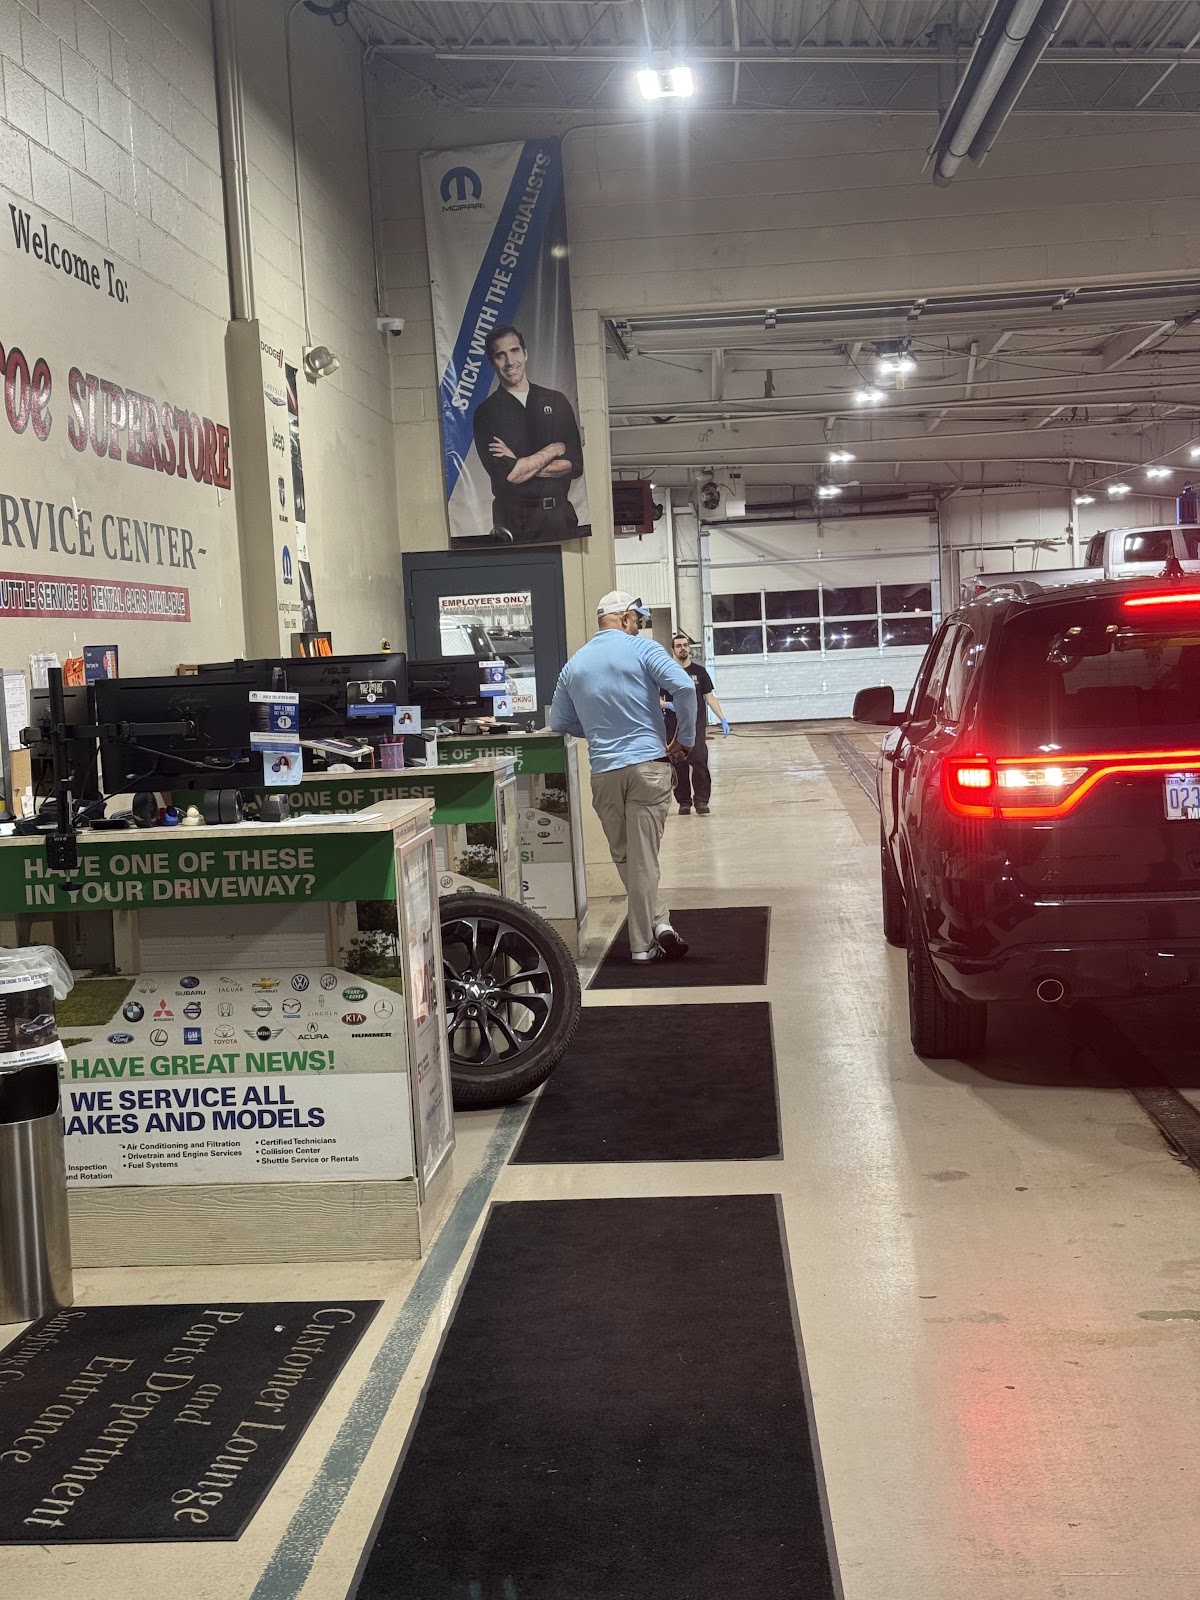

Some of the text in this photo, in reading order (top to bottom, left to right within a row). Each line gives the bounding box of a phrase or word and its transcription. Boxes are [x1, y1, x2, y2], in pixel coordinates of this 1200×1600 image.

[442, 203, 484, 212] MOPAR
[8, 203, 129, 304] Welcome To:
[452, 151, 551, 411] STICK WITH THE SPECIALISTS
[261, 341, 281, 361] DODGE
[67, 366, 231, 490] SUPERSTORE
[272, 425, 285, 458] Jeep
[0, 579, 186, 617] UTTLE SERVICE & RENTAL CARS AVAILABLE
[442, 596, 501, 608] EMPLOYEE'S
[503, 595, 530, 604] ONLY
[511, 695, 532, 704] OKING
[452, 748, 471, 761] OF
[477, 745, 523, 760] THESE
[288, 790, 331, 808] ONE
[338, 788, 364, 805] OF
[370, 786, 435, 802] THESE
[109, 852, 170, 876] ONE
[178, 851, 214, 873] OF
[223, 847, 315, 872] THESE
[25, 873, 316, 905] IN YOUR DRIVEWAY?
[345, 1014, 363, 1022] KIA
[112, 1035, 129, 1043] Ford
[71, 1056, 145, 1079] HAVE
[150, 1053, 240, 1076] GREAT
[245, 1050, 335, 1073] NEWS!
[70, 1085, 294, 1112] WE SERVICE ALL
[145, 1111, 206, 1133] AND
[212, 1107, 325, 1131] MODELS
[139, 1142, 189, 1151] Conditioning
[190, 1141, 204, 1149] and
[206, 1140, 241, 1148] Filtration
[260, 1137, 337, 1146] Certified Technicians
[261, 1146, 320, 1155] Collision Center
[127, 1150, 242, 1160] Drivetrain and Engine Services
[128, 1161, 178, 1170] Fuel Systems
[262, 1156, 289, 1164] Shuttle
[291, 1155, 319, 1163] Service
[331, 1155, 359, 1163] Rentals
[68, 1163, 107, 1172] Inspection
[80, 1172, 113, 1180] Rotation
[1, 1355, 137, 1464] Entrance
[174, 1383, 222, 1427] and
[23, 1309, 244, 1529] Parts Department
[171, 1308, 356, 1524] Customer Lounge
